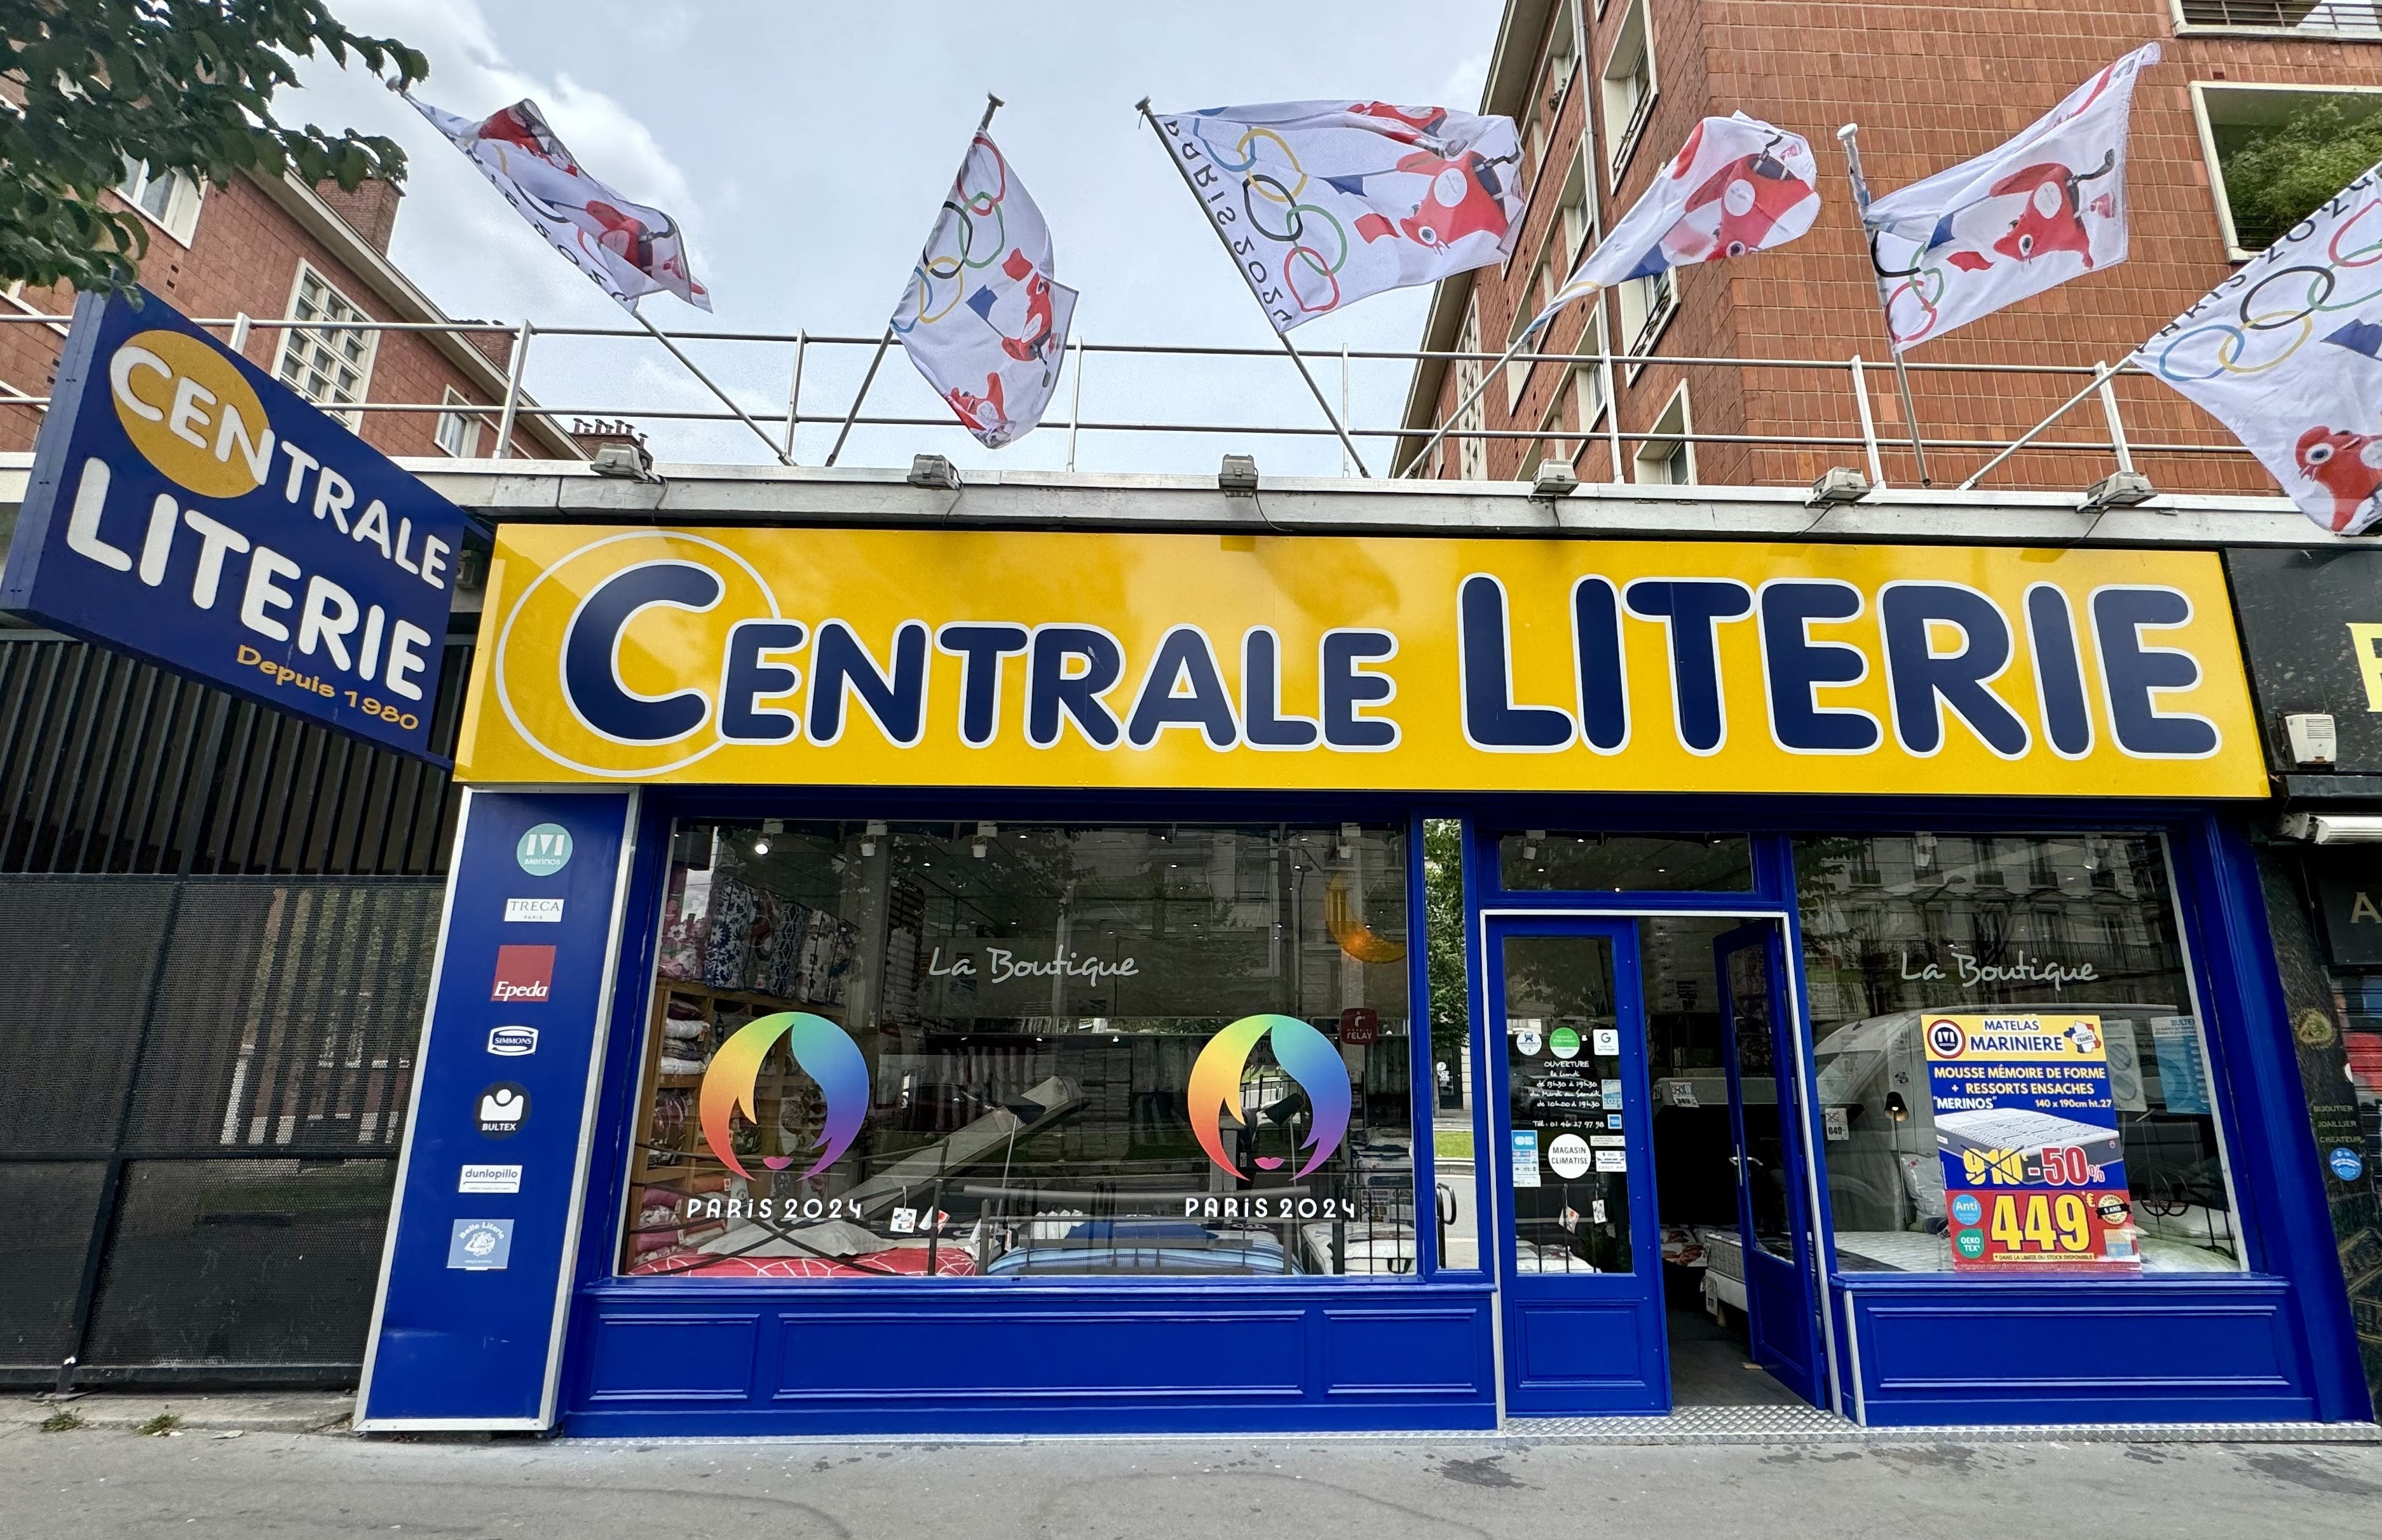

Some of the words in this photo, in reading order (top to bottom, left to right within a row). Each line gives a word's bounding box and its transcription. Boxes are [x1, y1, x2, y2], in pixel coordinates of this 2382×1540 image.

[110, 346, 451, 590] CENTRALE
[67, 456, 432, 701] LITERIE
[560, 559, 1402, 753] CENTRALE
[1457, 571, 2222, 760] LITERIE
[236, 644, 336, 698] Depuis
[344, 691, 419, 730] 1980
[510, 901, 560, 911] TRECA
[929, 946, 976, 977] La
[986, 944, 1139, 987] Boutique
[1901, 951, 1946, 981] La
[1951, 950, 2099, 991] Boutique
[494, 981, 548, 1001] Epeda
[1985, 1020, 2039, 1030] MATELAS
[1971, 1036, 2064, 1051] MARINIERE
[1934, 1066, 1985, 1079] MOUSSE
[1988, 1064, 2045, 1079] MÉMOIRE
[2046, 1067, 2062, 1079] DE
[2065, 1067, 2106, 1079] FORME
[1966, 1083, 2029, 1094] RESSORTS
[2031, 1083, 2095, 1094] ENSACHES
[2035, 1100, 2050, 1108] 140
[2060, 1100, 2087, 1108] 190cm
[465, 1169, 518, 1180] dunlopillo
[784, 1198, 862, 1218] 2024
[1279, 1198, 1355, 1218] 2024
[1956, 1202, 1978, 1211] Anti
[459, 1223, 480, 1239] Belle
[482, 1222, 505, 1239] Literie
